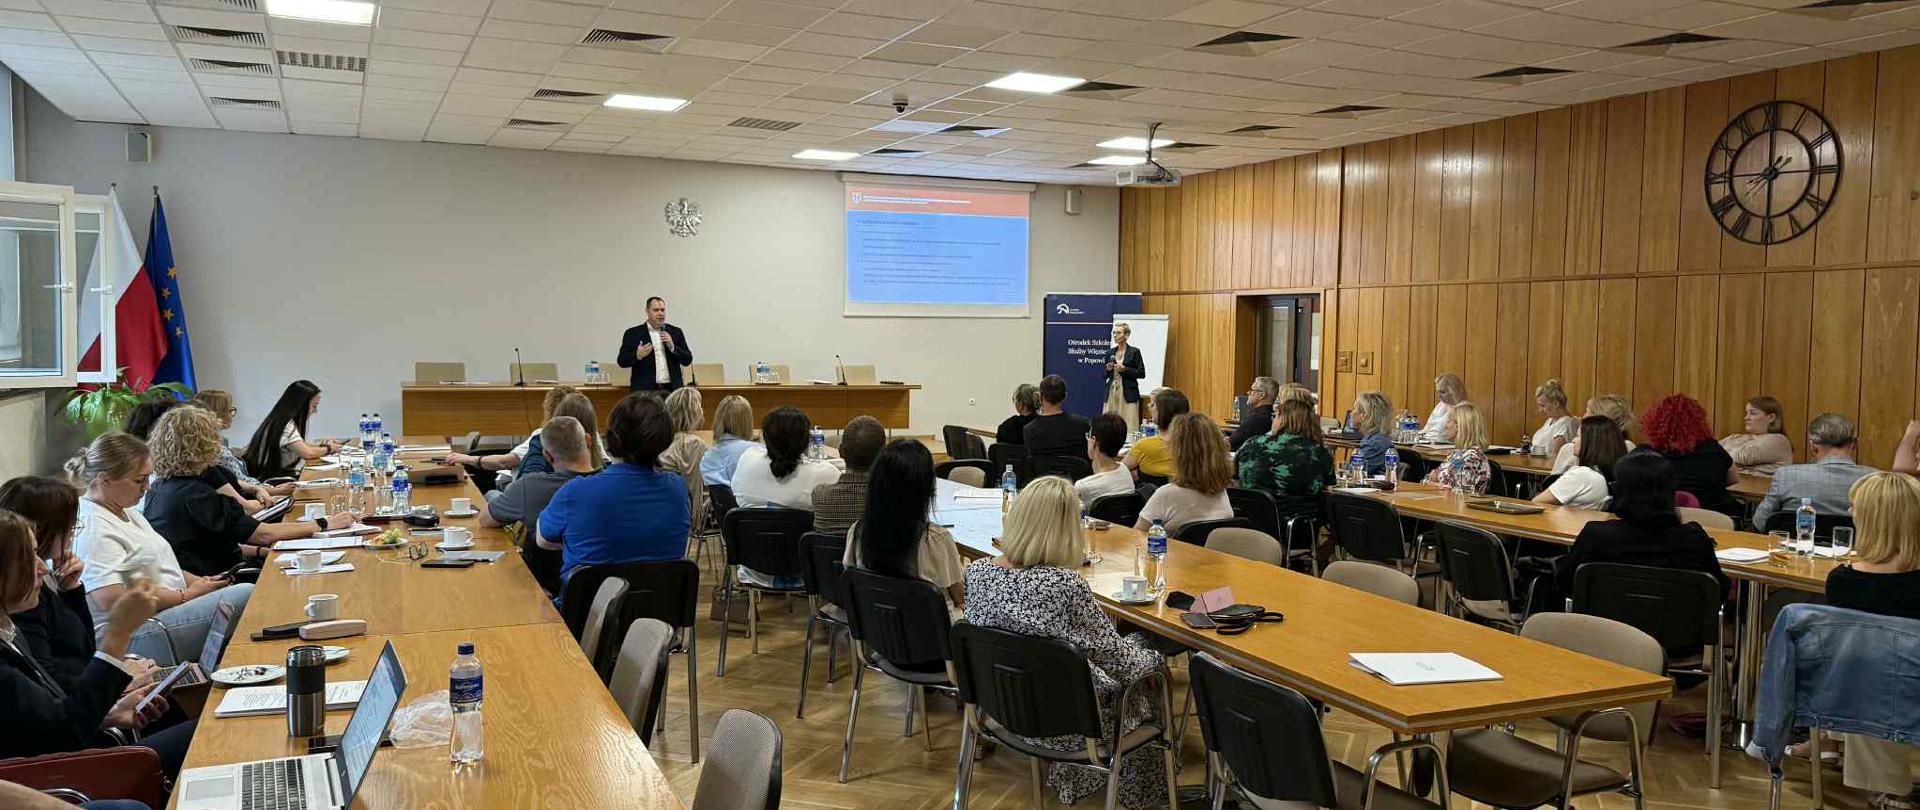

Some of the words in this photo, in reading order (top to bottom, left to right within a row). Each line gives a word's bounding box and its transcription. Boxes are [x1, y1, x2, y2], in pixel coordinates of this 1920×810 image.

[1092, 338, 1112, 346] Szkole
[1087, 347, 1107, 355] Więzie
[1084, 357, 1105, 365] Popowi
